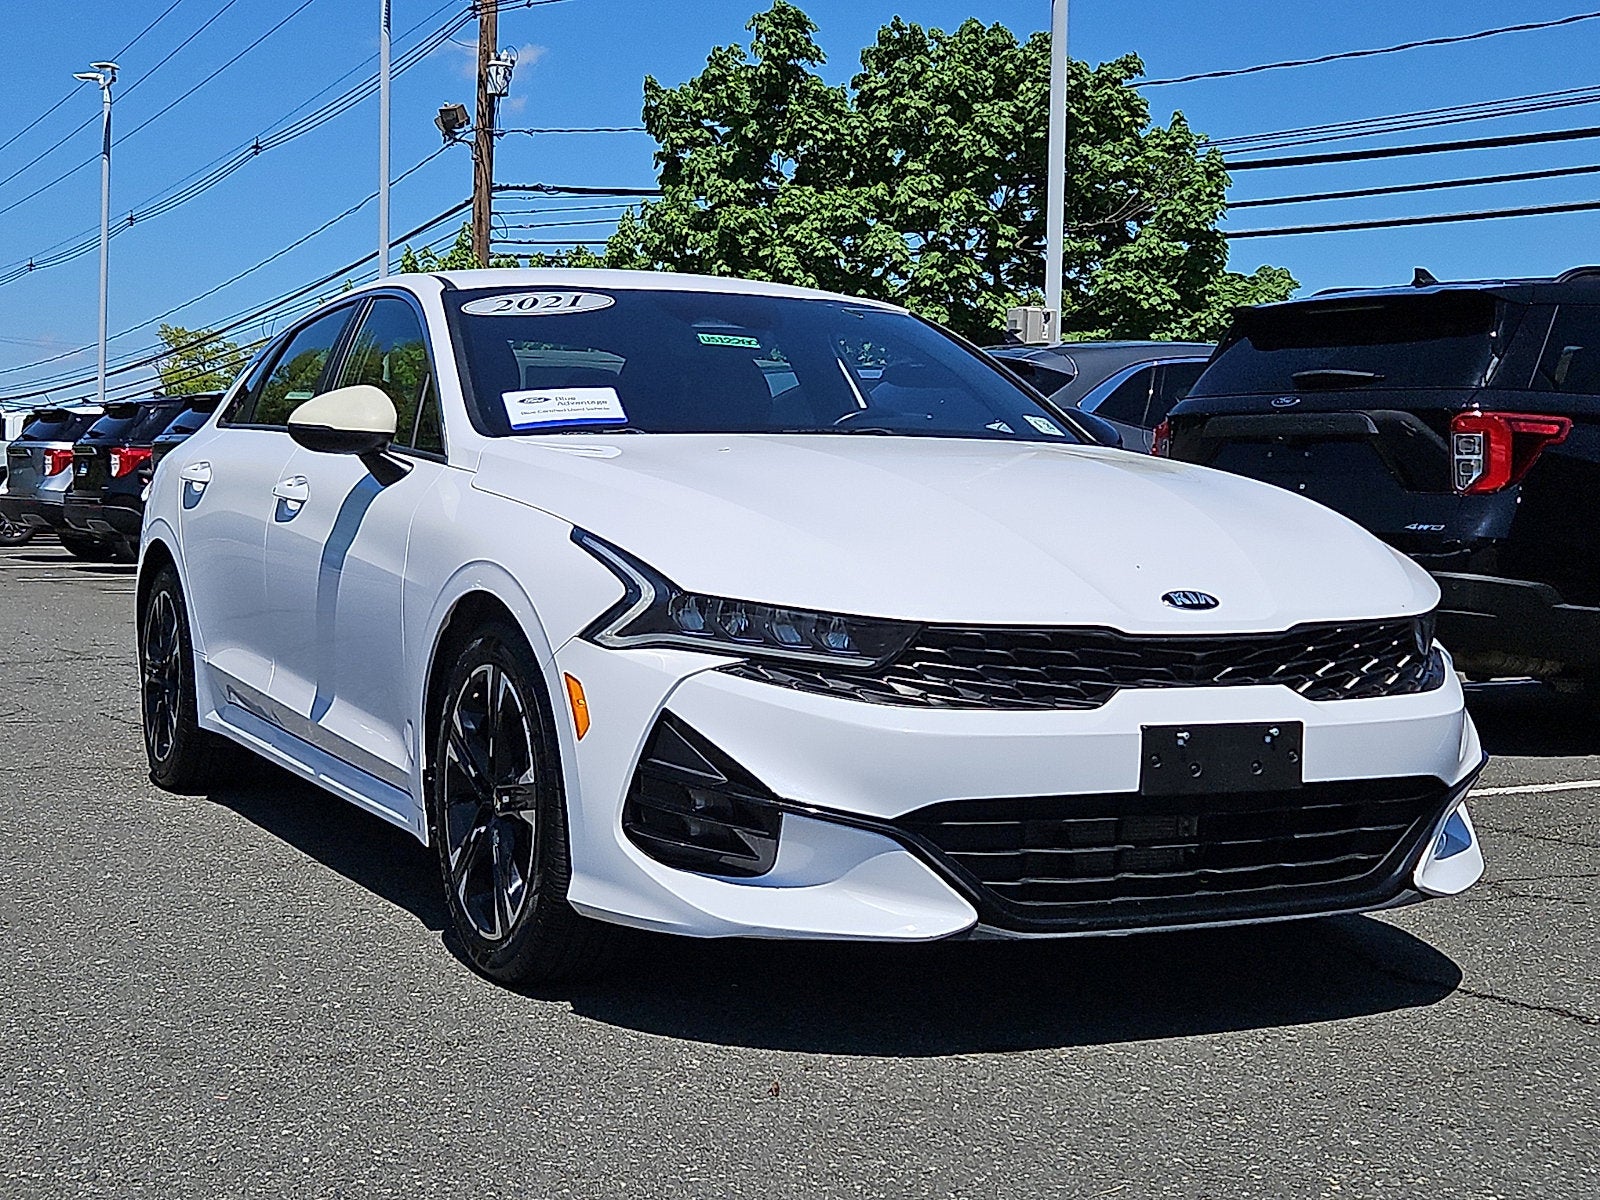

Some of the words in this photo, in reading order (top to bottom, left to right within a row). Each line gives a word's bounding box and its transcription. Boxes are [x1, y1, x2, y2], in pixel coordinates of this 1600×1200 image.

[491, 294, 584, 312] 2021
[1404, 523, 1446, 531] 4WD
[1168, 591, 1217, 606] KIA
